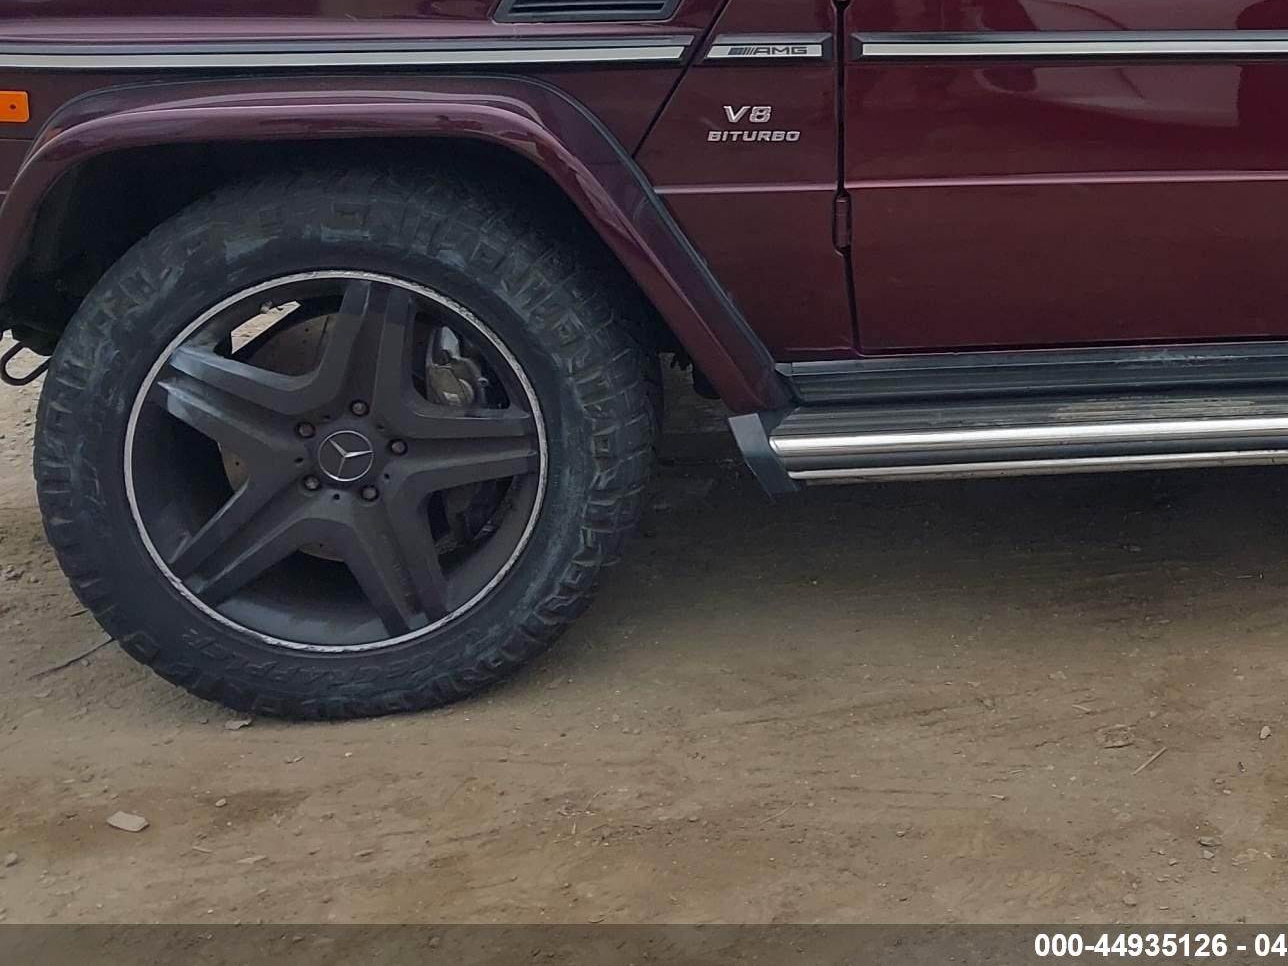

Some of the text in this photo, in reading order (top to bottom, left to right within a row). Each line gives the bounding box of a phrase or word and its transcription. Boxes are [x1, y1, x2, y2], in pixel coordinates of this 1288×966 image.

[753, 45, 808, 56] AMG
[722, 105, 772, 124] V8
[706, 130, 801, 142] BITURBO
